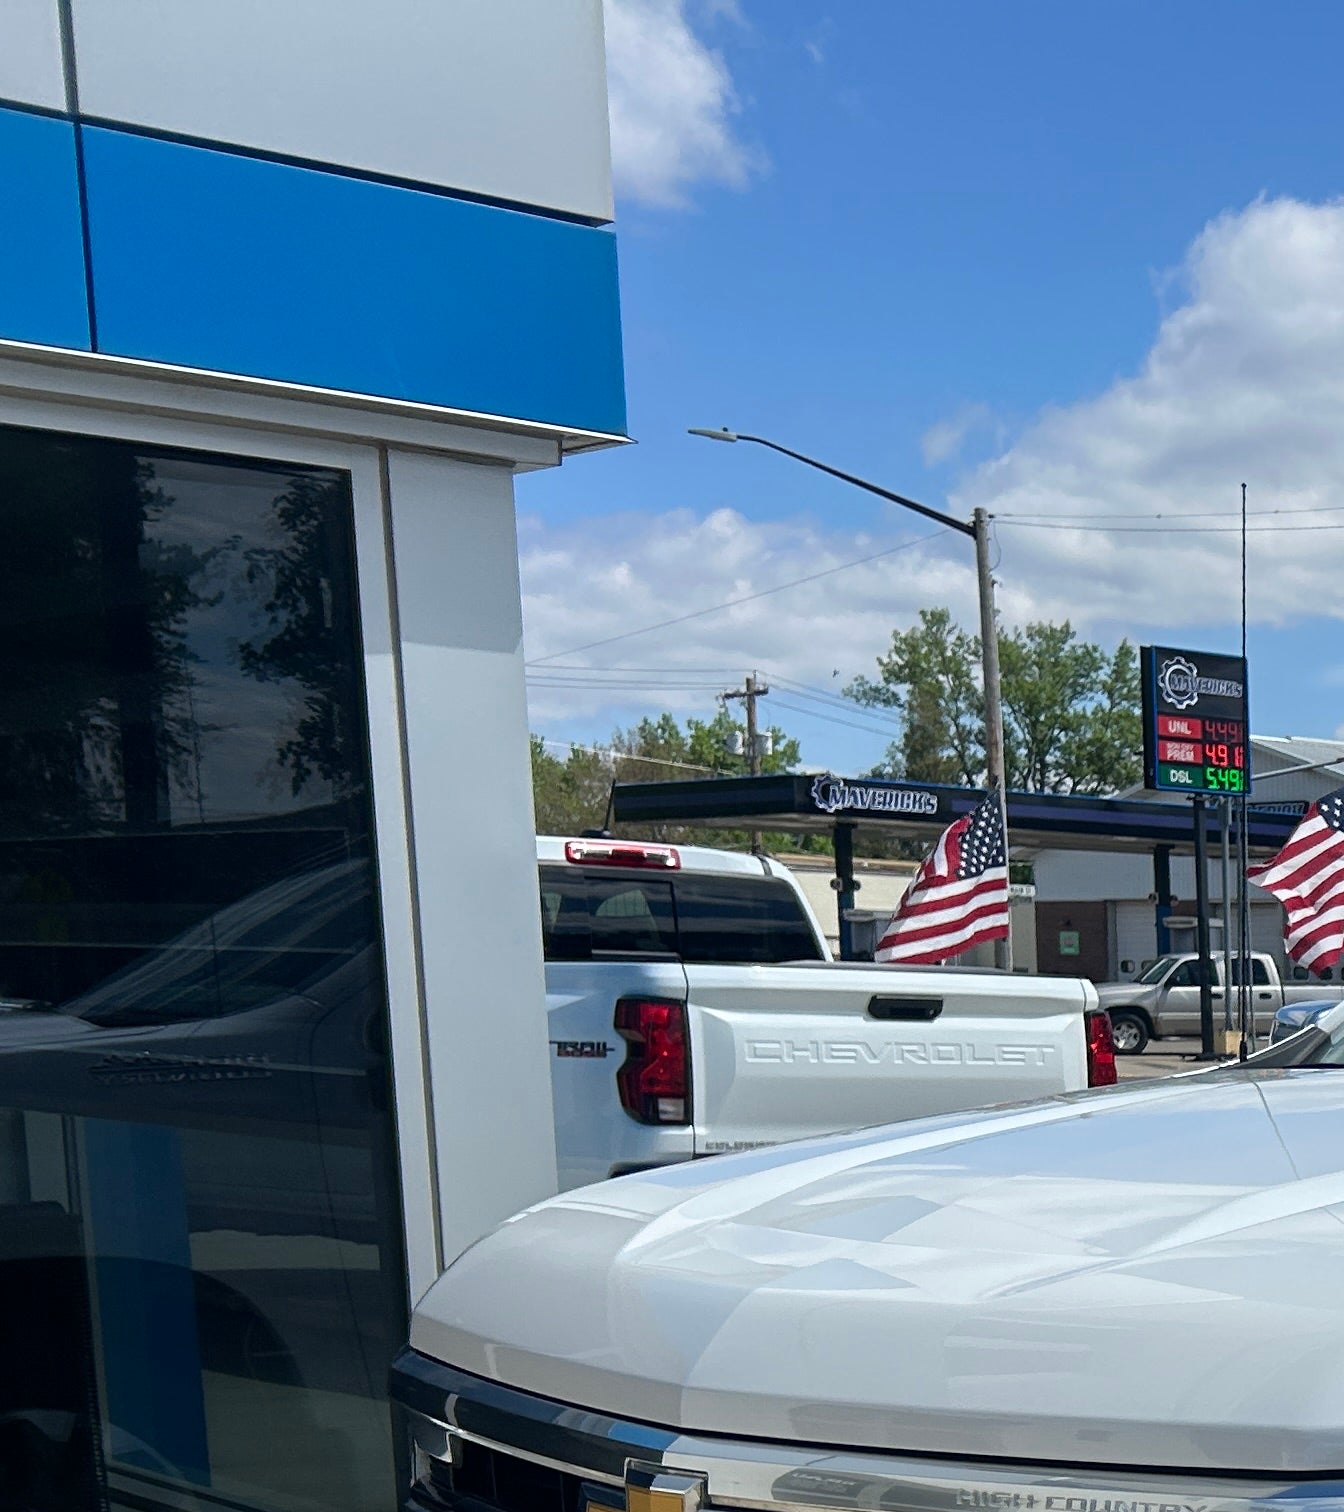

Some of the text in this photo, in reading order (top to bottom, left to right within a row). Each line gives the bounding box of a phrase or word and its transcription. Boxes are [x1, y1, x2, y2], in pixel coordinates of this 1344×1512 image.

[1168, 720, 1192, 735] UNL
[1170, 769, 1192, 783] DSL
[745, 1038, 1056, 1066] CHEVROLET
[956, 1488, 1040, 1509] HIGH
